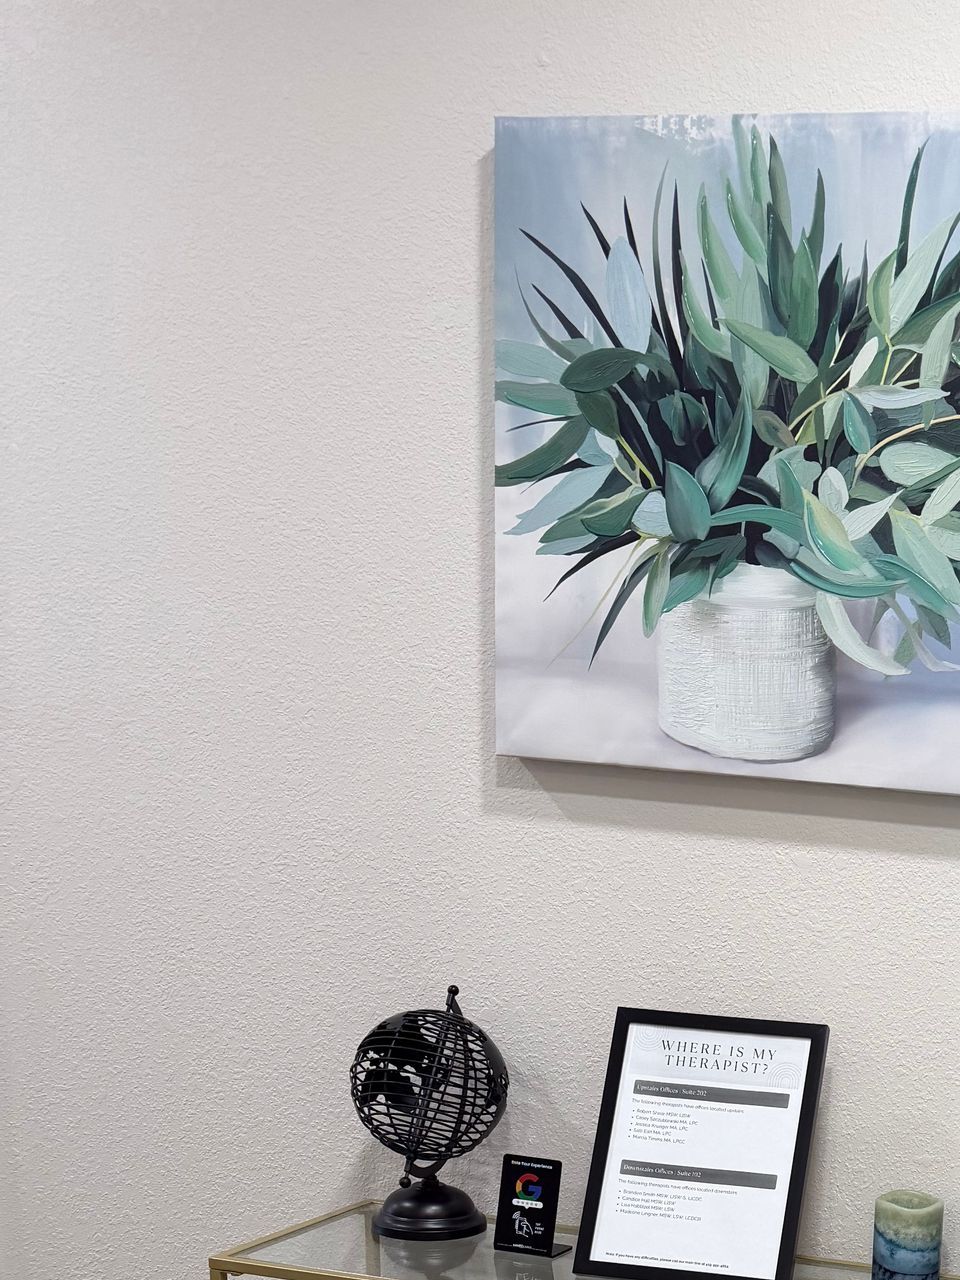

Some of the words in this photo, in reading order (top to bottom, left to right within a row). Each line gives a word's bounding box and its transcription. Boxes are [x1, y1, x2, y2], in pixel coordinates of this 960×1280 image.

[661, 1039, 722, 1056] WHERE
[729, 1046, 745, 1058] IS
[752, 1048, 777, 1060] MY
[665, 1055, 768, 1074] THERAPIST?
